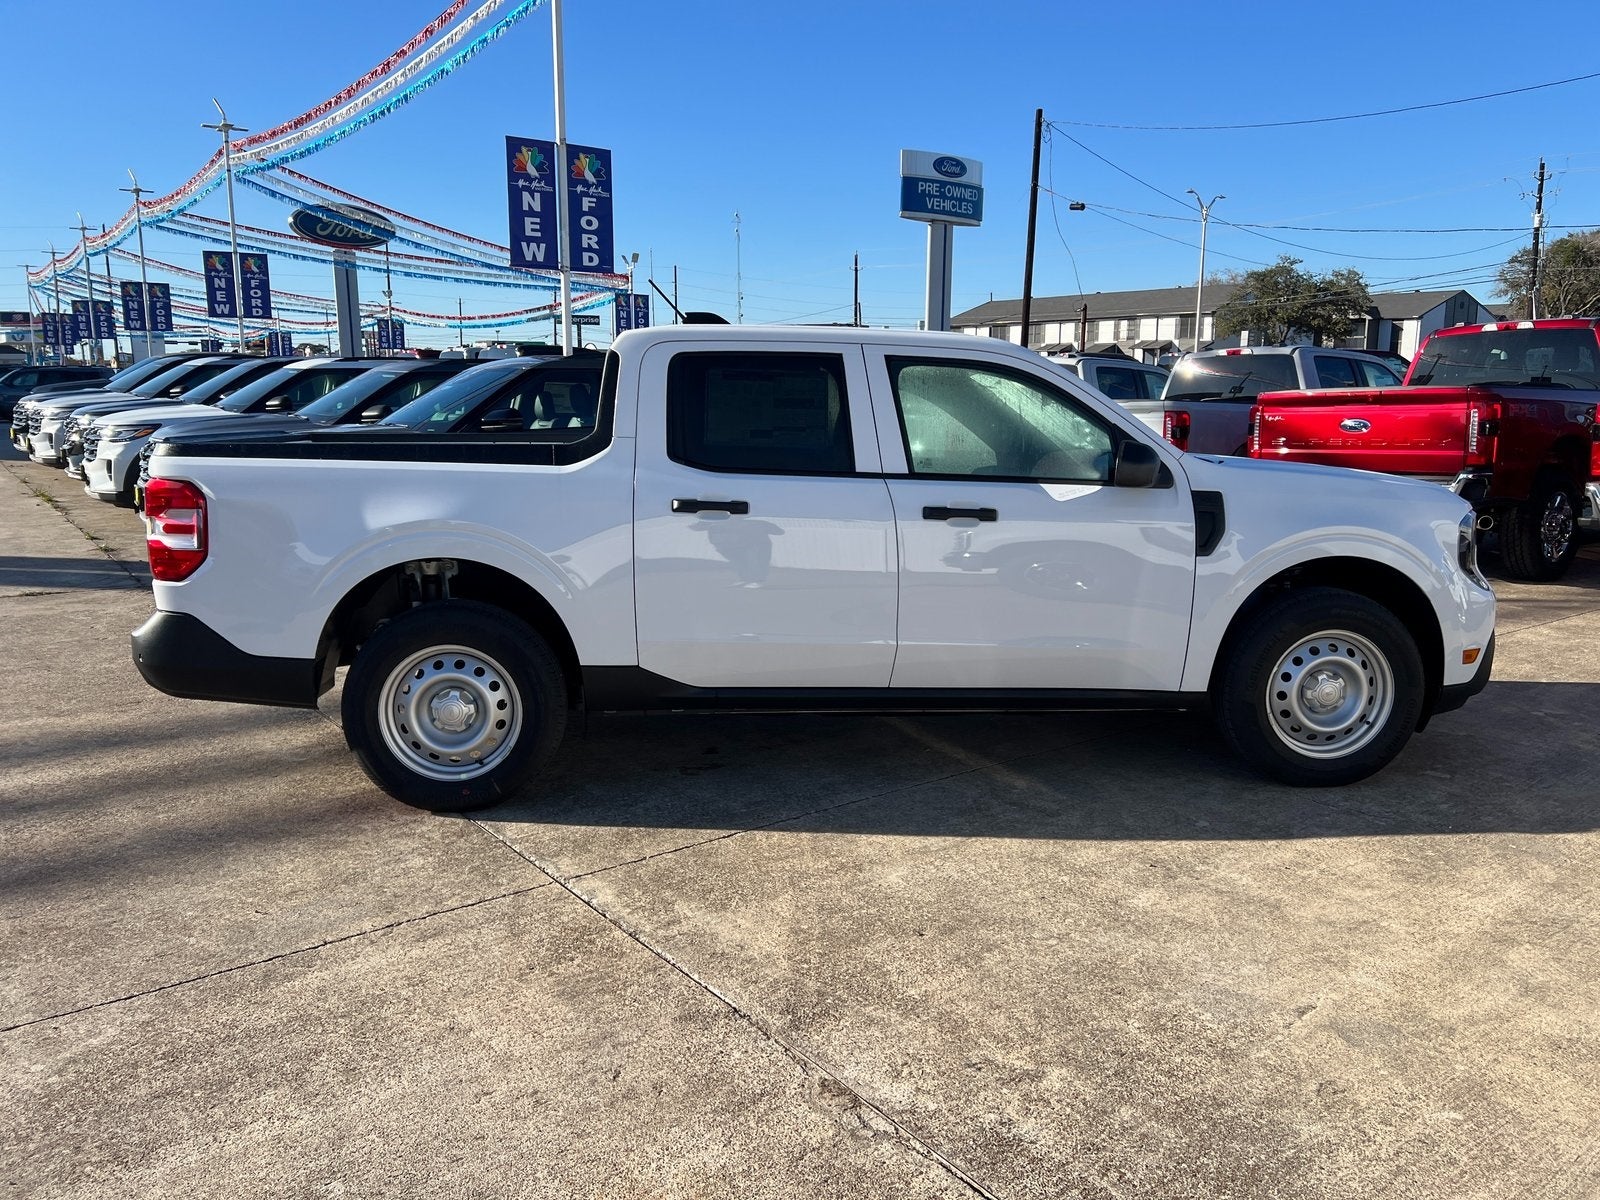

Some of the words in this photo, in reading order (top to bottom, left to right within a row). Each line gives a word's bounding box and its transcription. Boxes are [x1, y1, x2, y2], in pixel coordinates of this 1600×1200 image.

[941, 160, 962, 173] Ford
[918, 182, 979, 200] PRE-OWNED
[926, 197, 973, 214] VEHICLES
[521, 191, 546, 262] NEW
[580, 197, 600, 266] FORD
[213, 278, 230, 315] NEW
[249, 280, 263, 316] FORD
[78, 315, 88, 337] NEW
[100, 316, 109, 338] FORD
[128, 301, 140, 329] NEW
[156, 302, 166, 330] FORD
